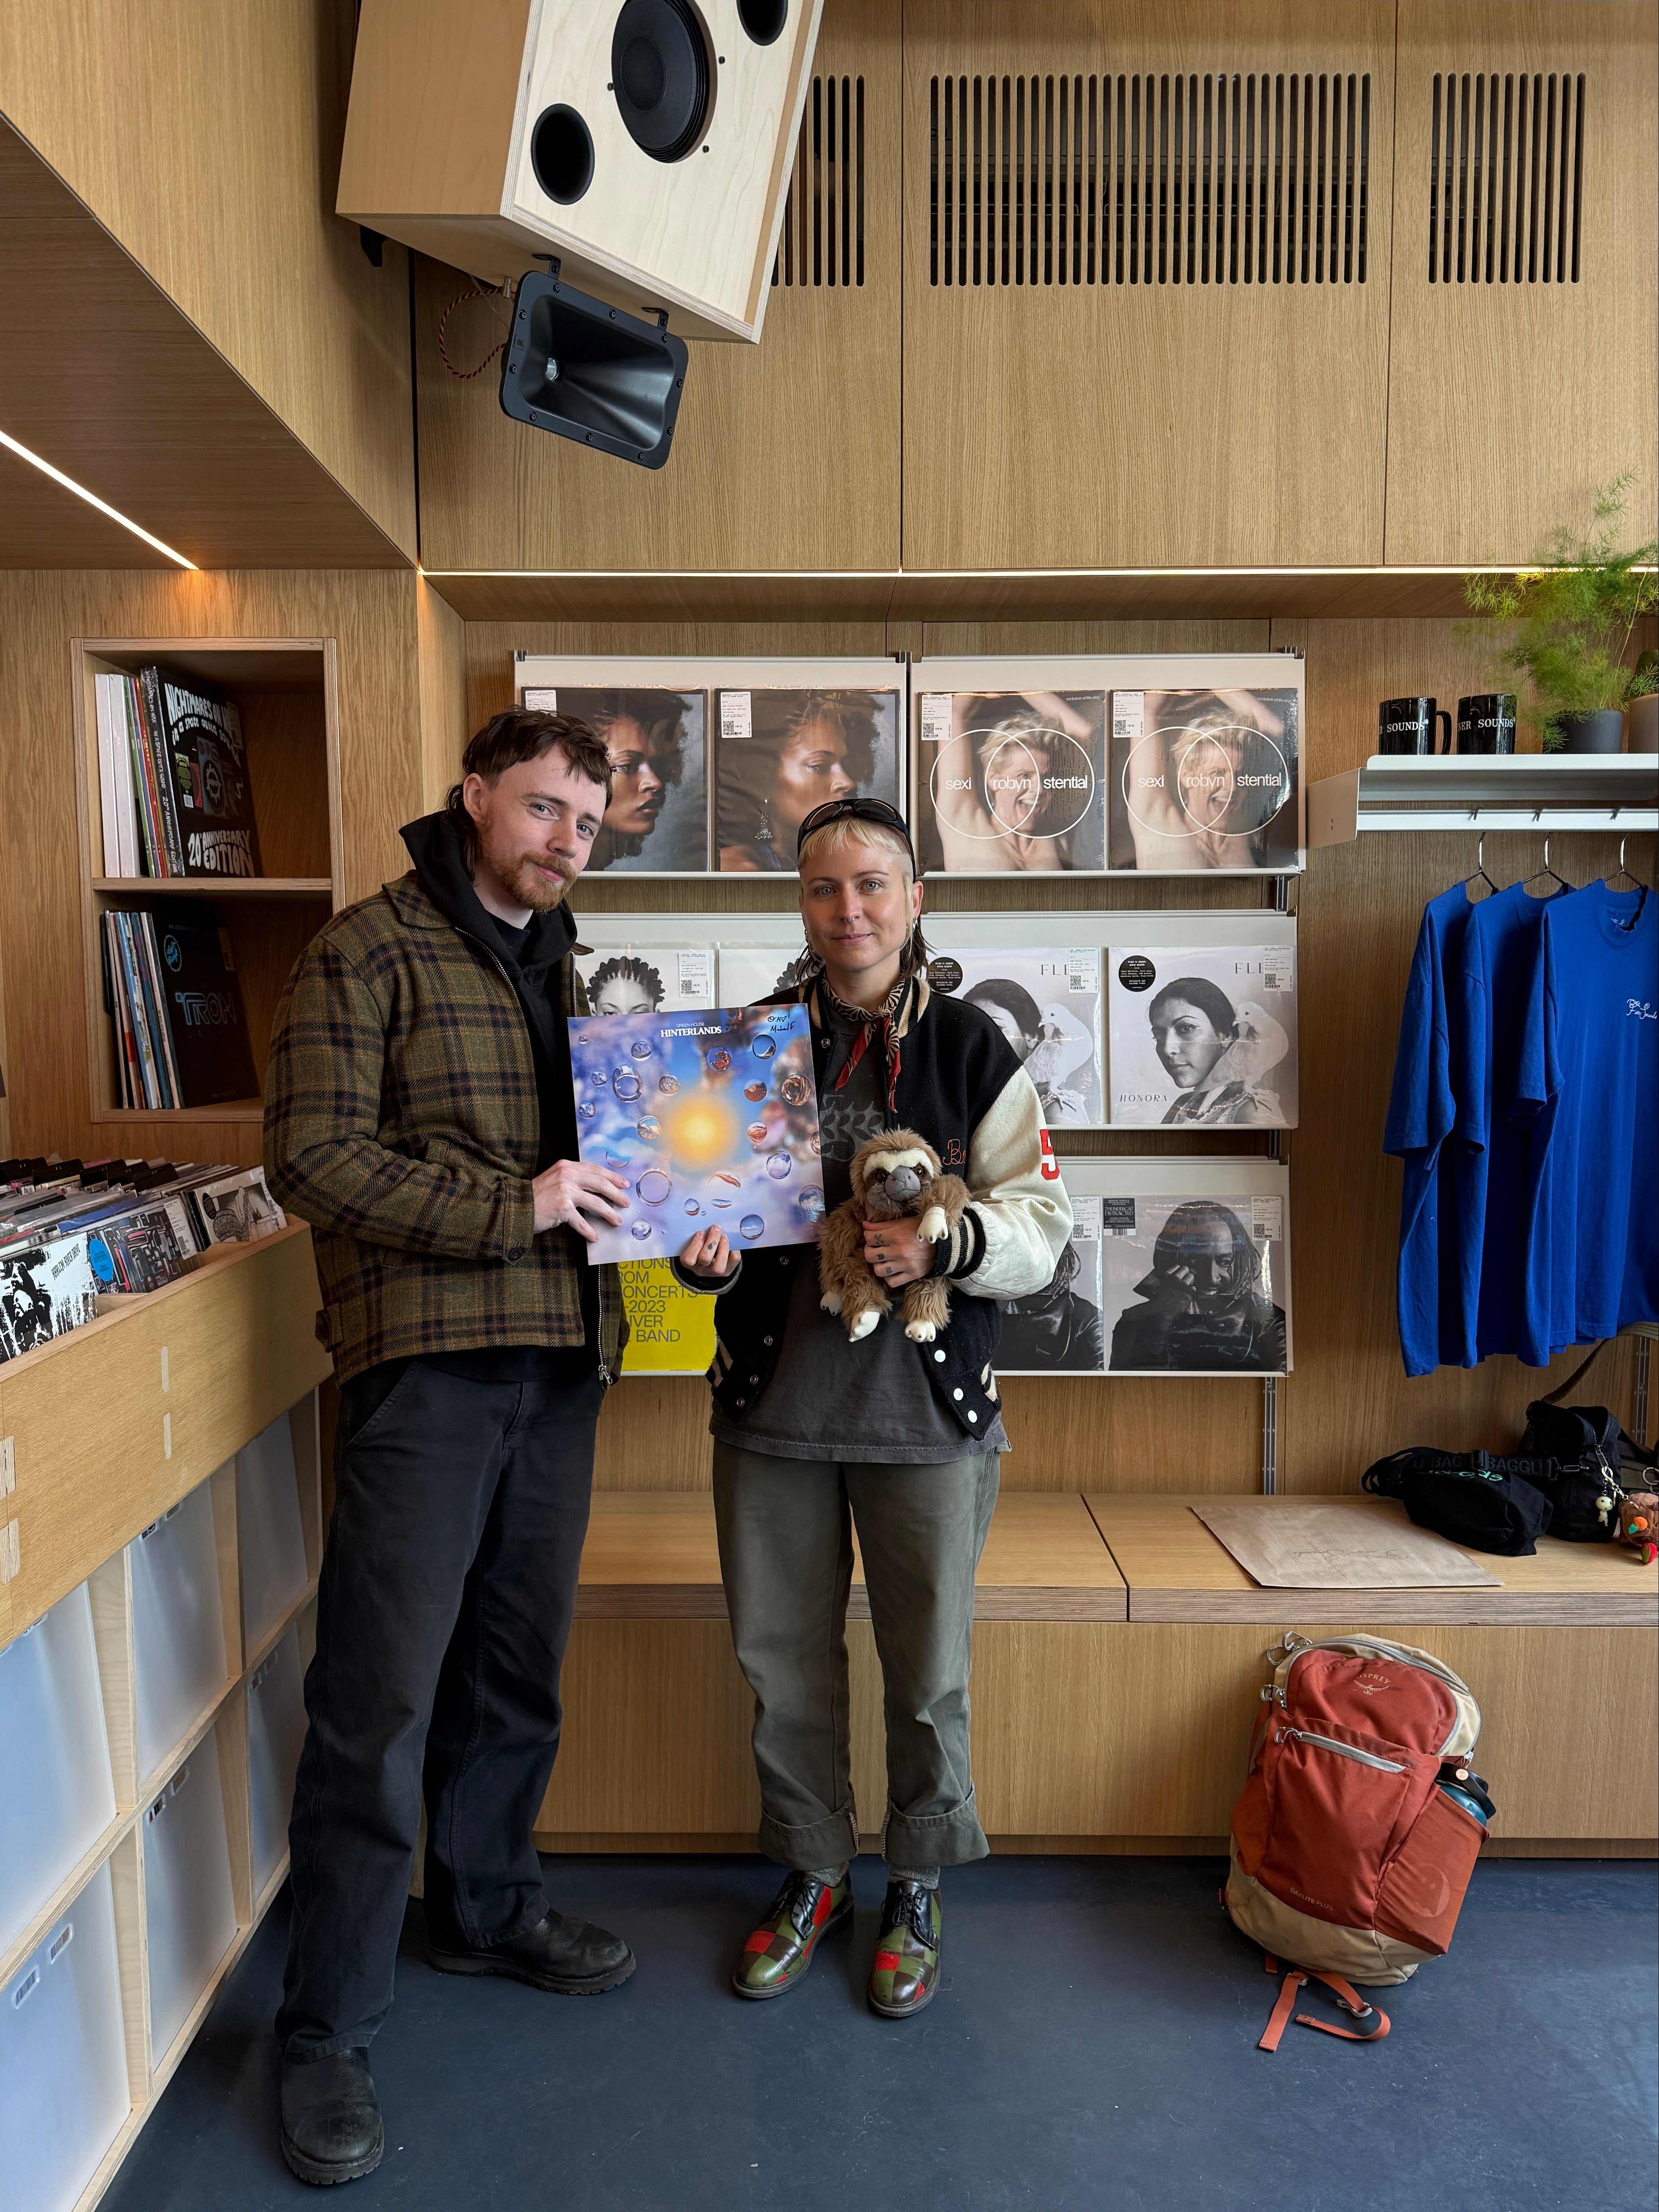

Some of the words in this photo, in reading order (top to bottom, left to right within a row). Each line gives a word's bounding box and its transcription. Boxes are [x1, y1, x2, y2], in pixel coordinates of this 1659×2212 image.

[164, 683, 213, 726] NIGHTMARES
[1387, 722, 1425, 733] SOUNDS
[1478, 719, 1514, 728] SOUNDS
[172, 728, 179, 746] in
[179, 721, 184, 733] a
[945, 778, 971, 790] sexi
[993, 776, 1031, 792] robyn
[1043, 775, 1088, 789] stential
[1138, 775, 1164, 788] sexi
[1186, 773, 1225, 790] robyn
[1237, 772, 1282, 786] stential
[202, 830, 250, 854] ANNIVERSARY
[203, 843, 255, 878] EDITION
[175, 992, 237, 1025] TRON
[660, 1026, 722, 1037] HINTERLANDS
[636, 1330, 681, 1342] BAND
[1431, 1456, 1462, 1467] BAG
[1290, 1887, 1315, 1904] DAYLITE
[1316, 1900, 1333, 1910] PLUS
